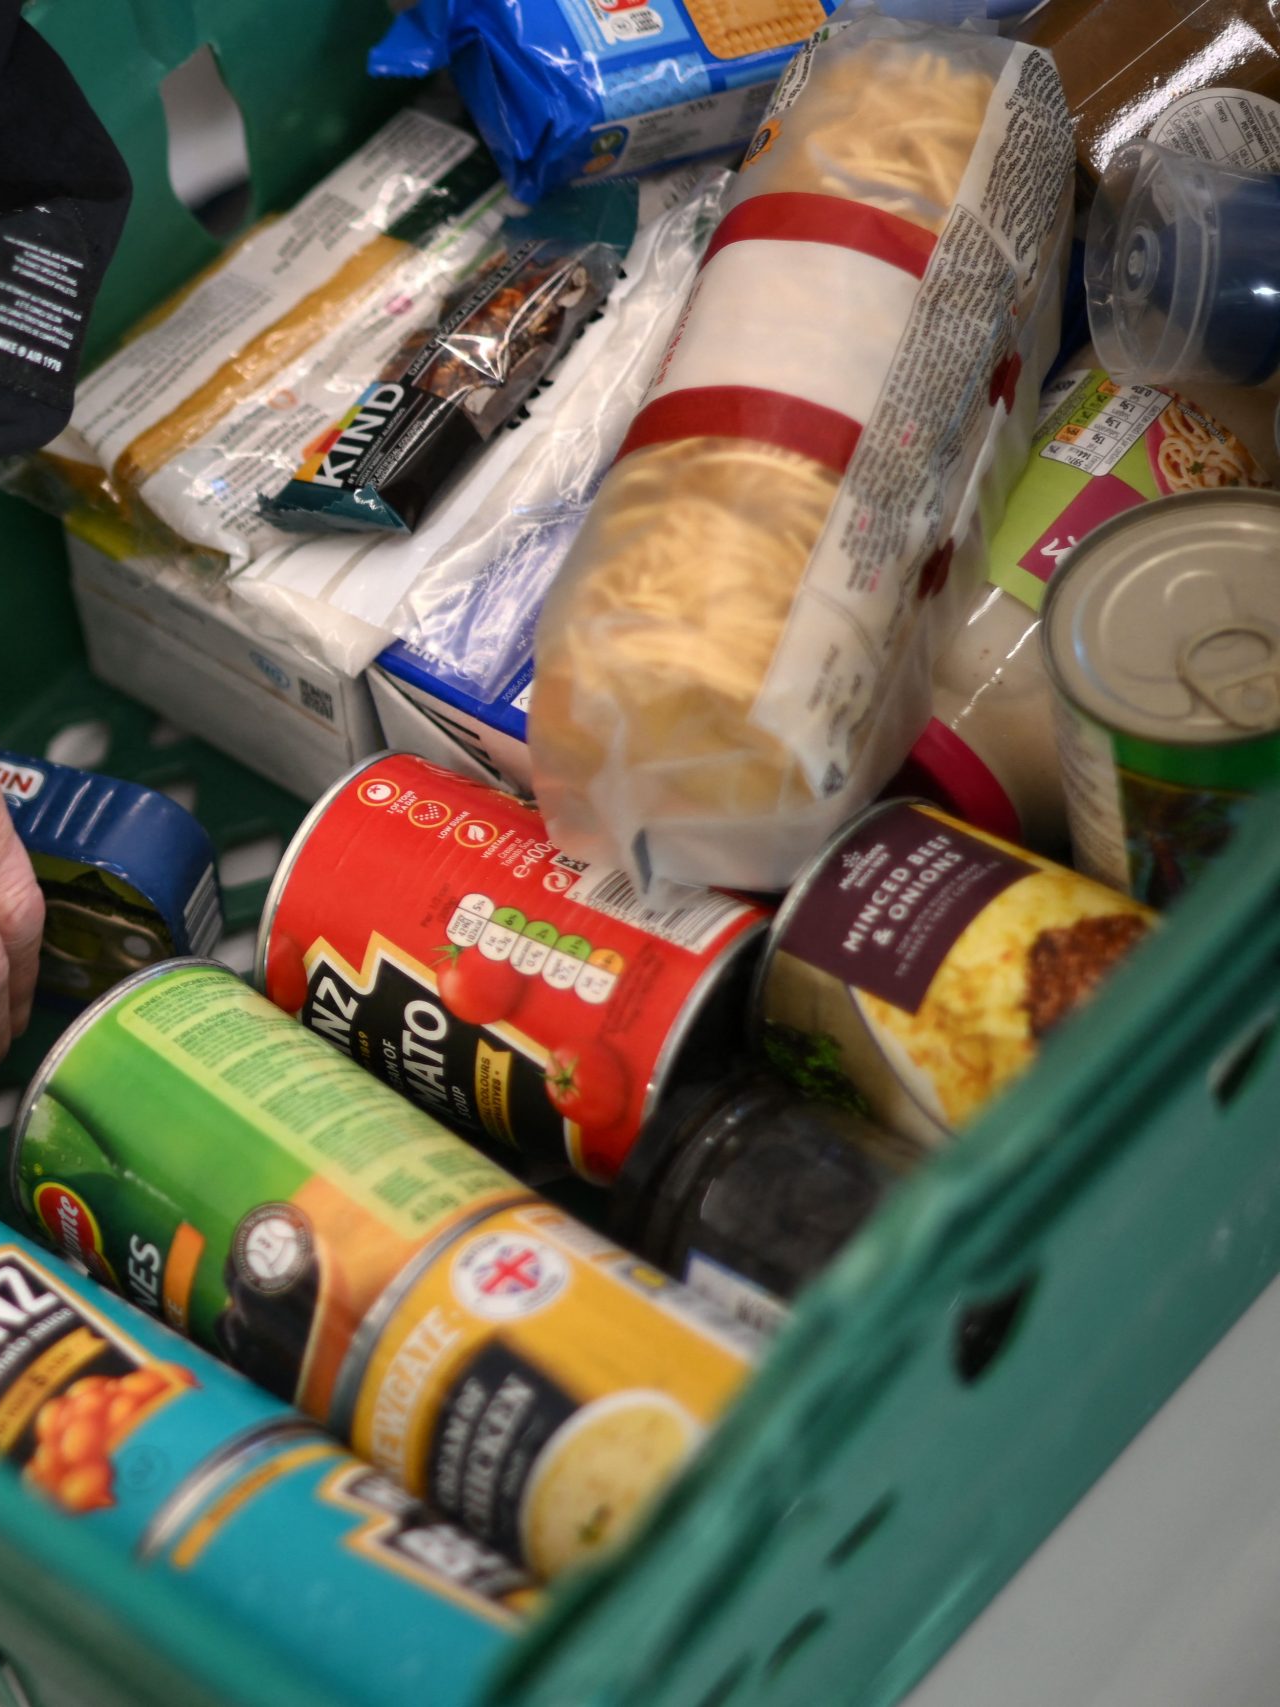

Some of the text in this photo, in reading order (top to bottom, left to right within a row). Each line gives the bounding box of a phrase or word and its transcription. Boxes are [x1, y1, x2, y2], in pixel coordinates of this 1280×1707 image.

[1190, 103, 1203, 117] Fat
[1212, 100, 1229, 124] Energy
[1185, 118, 1199, 136] which
[1250, 124, 1270, 155] INFORMATION
[25, 348, 44, 364] AIR
[40, 354, 63, 372] 1978
[312, 382, 404, 488] KIND
[1090, 432, 1105, 444] 13g
[399, 790, 416, 804] YOUR
[406, 795, 418, 806] DAY
[438, 810, 471, 839] LOW SUGAR
[481, 828, 516, 859] VEGETARIAN
[497, 842, 515, 860] Cream
[500, 847, 522, 868] Tomato
[839, 842, 886, 890] Morrisons
[471, 896, 486, 912] 5%
[842, 834, 953, 953] MINCED BEEF
[871, 850, 964, 947] & ONIONS
[446, 911, 465, 936] Energy
[464, 917, 484, 944] 102kcal
[502, 910, 518, 927] 6%
[382, 1038, 397, 1060] OF
[403, 1000, 448, 1103] MATO
[28, 1306, 74, 1341] sauce
[372, 1305, 464, 1470] EWGATE
